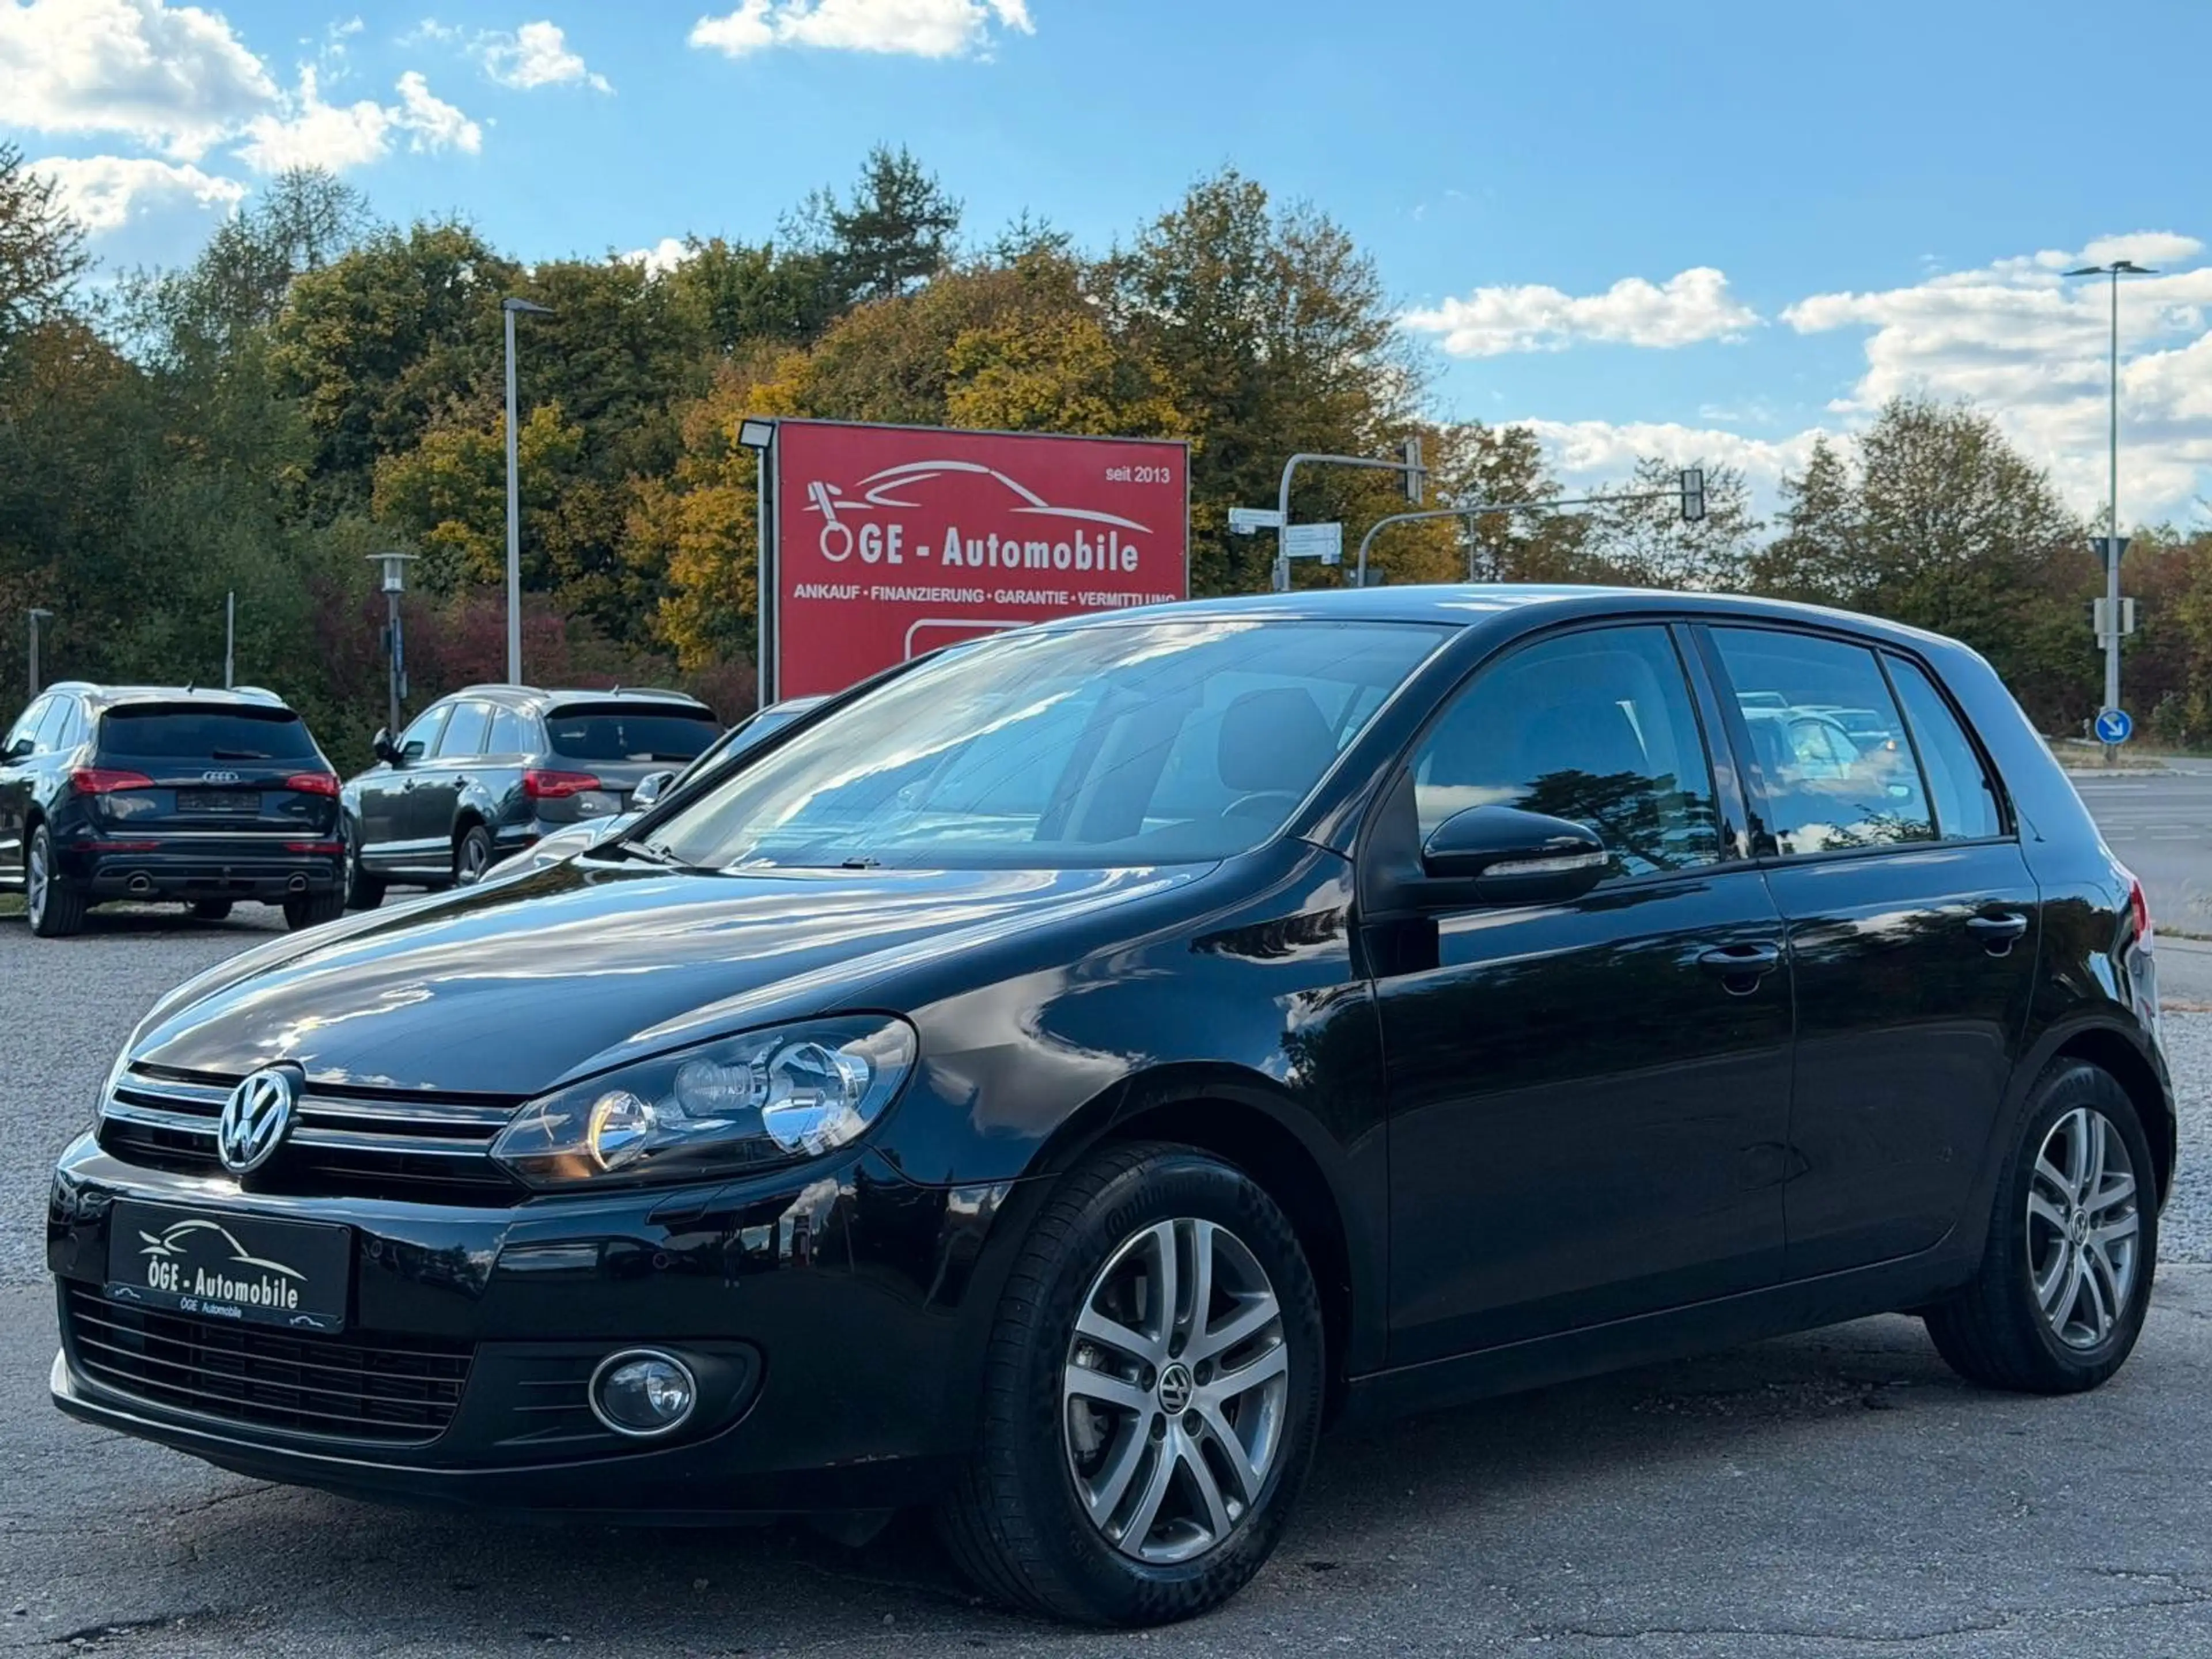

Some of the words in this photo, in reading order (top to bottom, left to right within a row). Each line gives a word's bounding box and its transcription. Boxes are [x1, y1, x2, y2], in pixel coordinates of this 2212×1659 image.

[1105, 465, 1132, 482] seit
[1134, 465, 1171, 484] 2013
[942, 527, 1139, 571] Automobile
[794, 584, 861, 600] ANKAUF
[871, 586, 984, 603] FINANZIERUNG
[994, 589, 1069, 605] GARANTIE
[194, 1267, 298, 1309] Automobile
